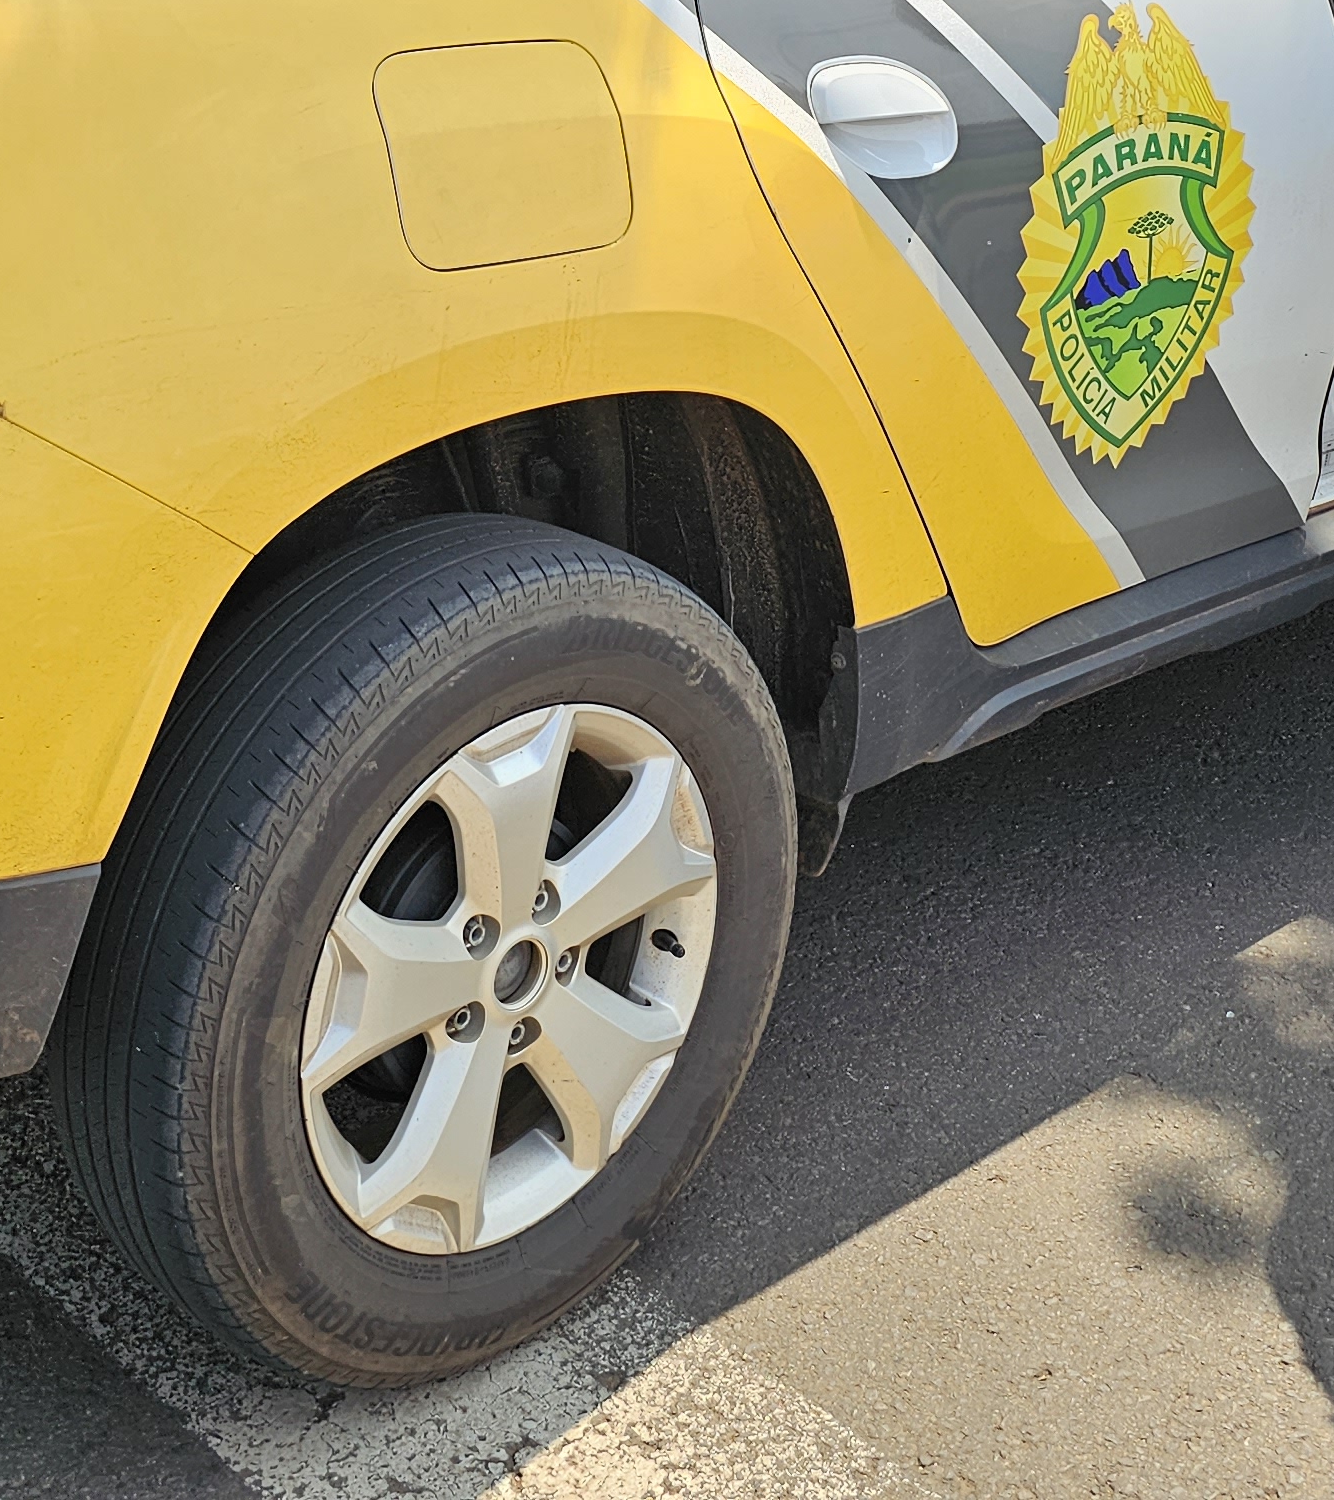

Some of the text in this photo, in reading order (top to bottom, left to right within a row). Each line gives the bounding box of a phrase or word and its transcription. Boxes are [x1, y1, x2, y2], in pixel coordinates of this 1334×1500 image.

[1064, 132, 1214, 206] PARANÁ
[1052, 308, 1117, 425] POLÍCIA
[1139, 268, 1220, 409] MILITAR
